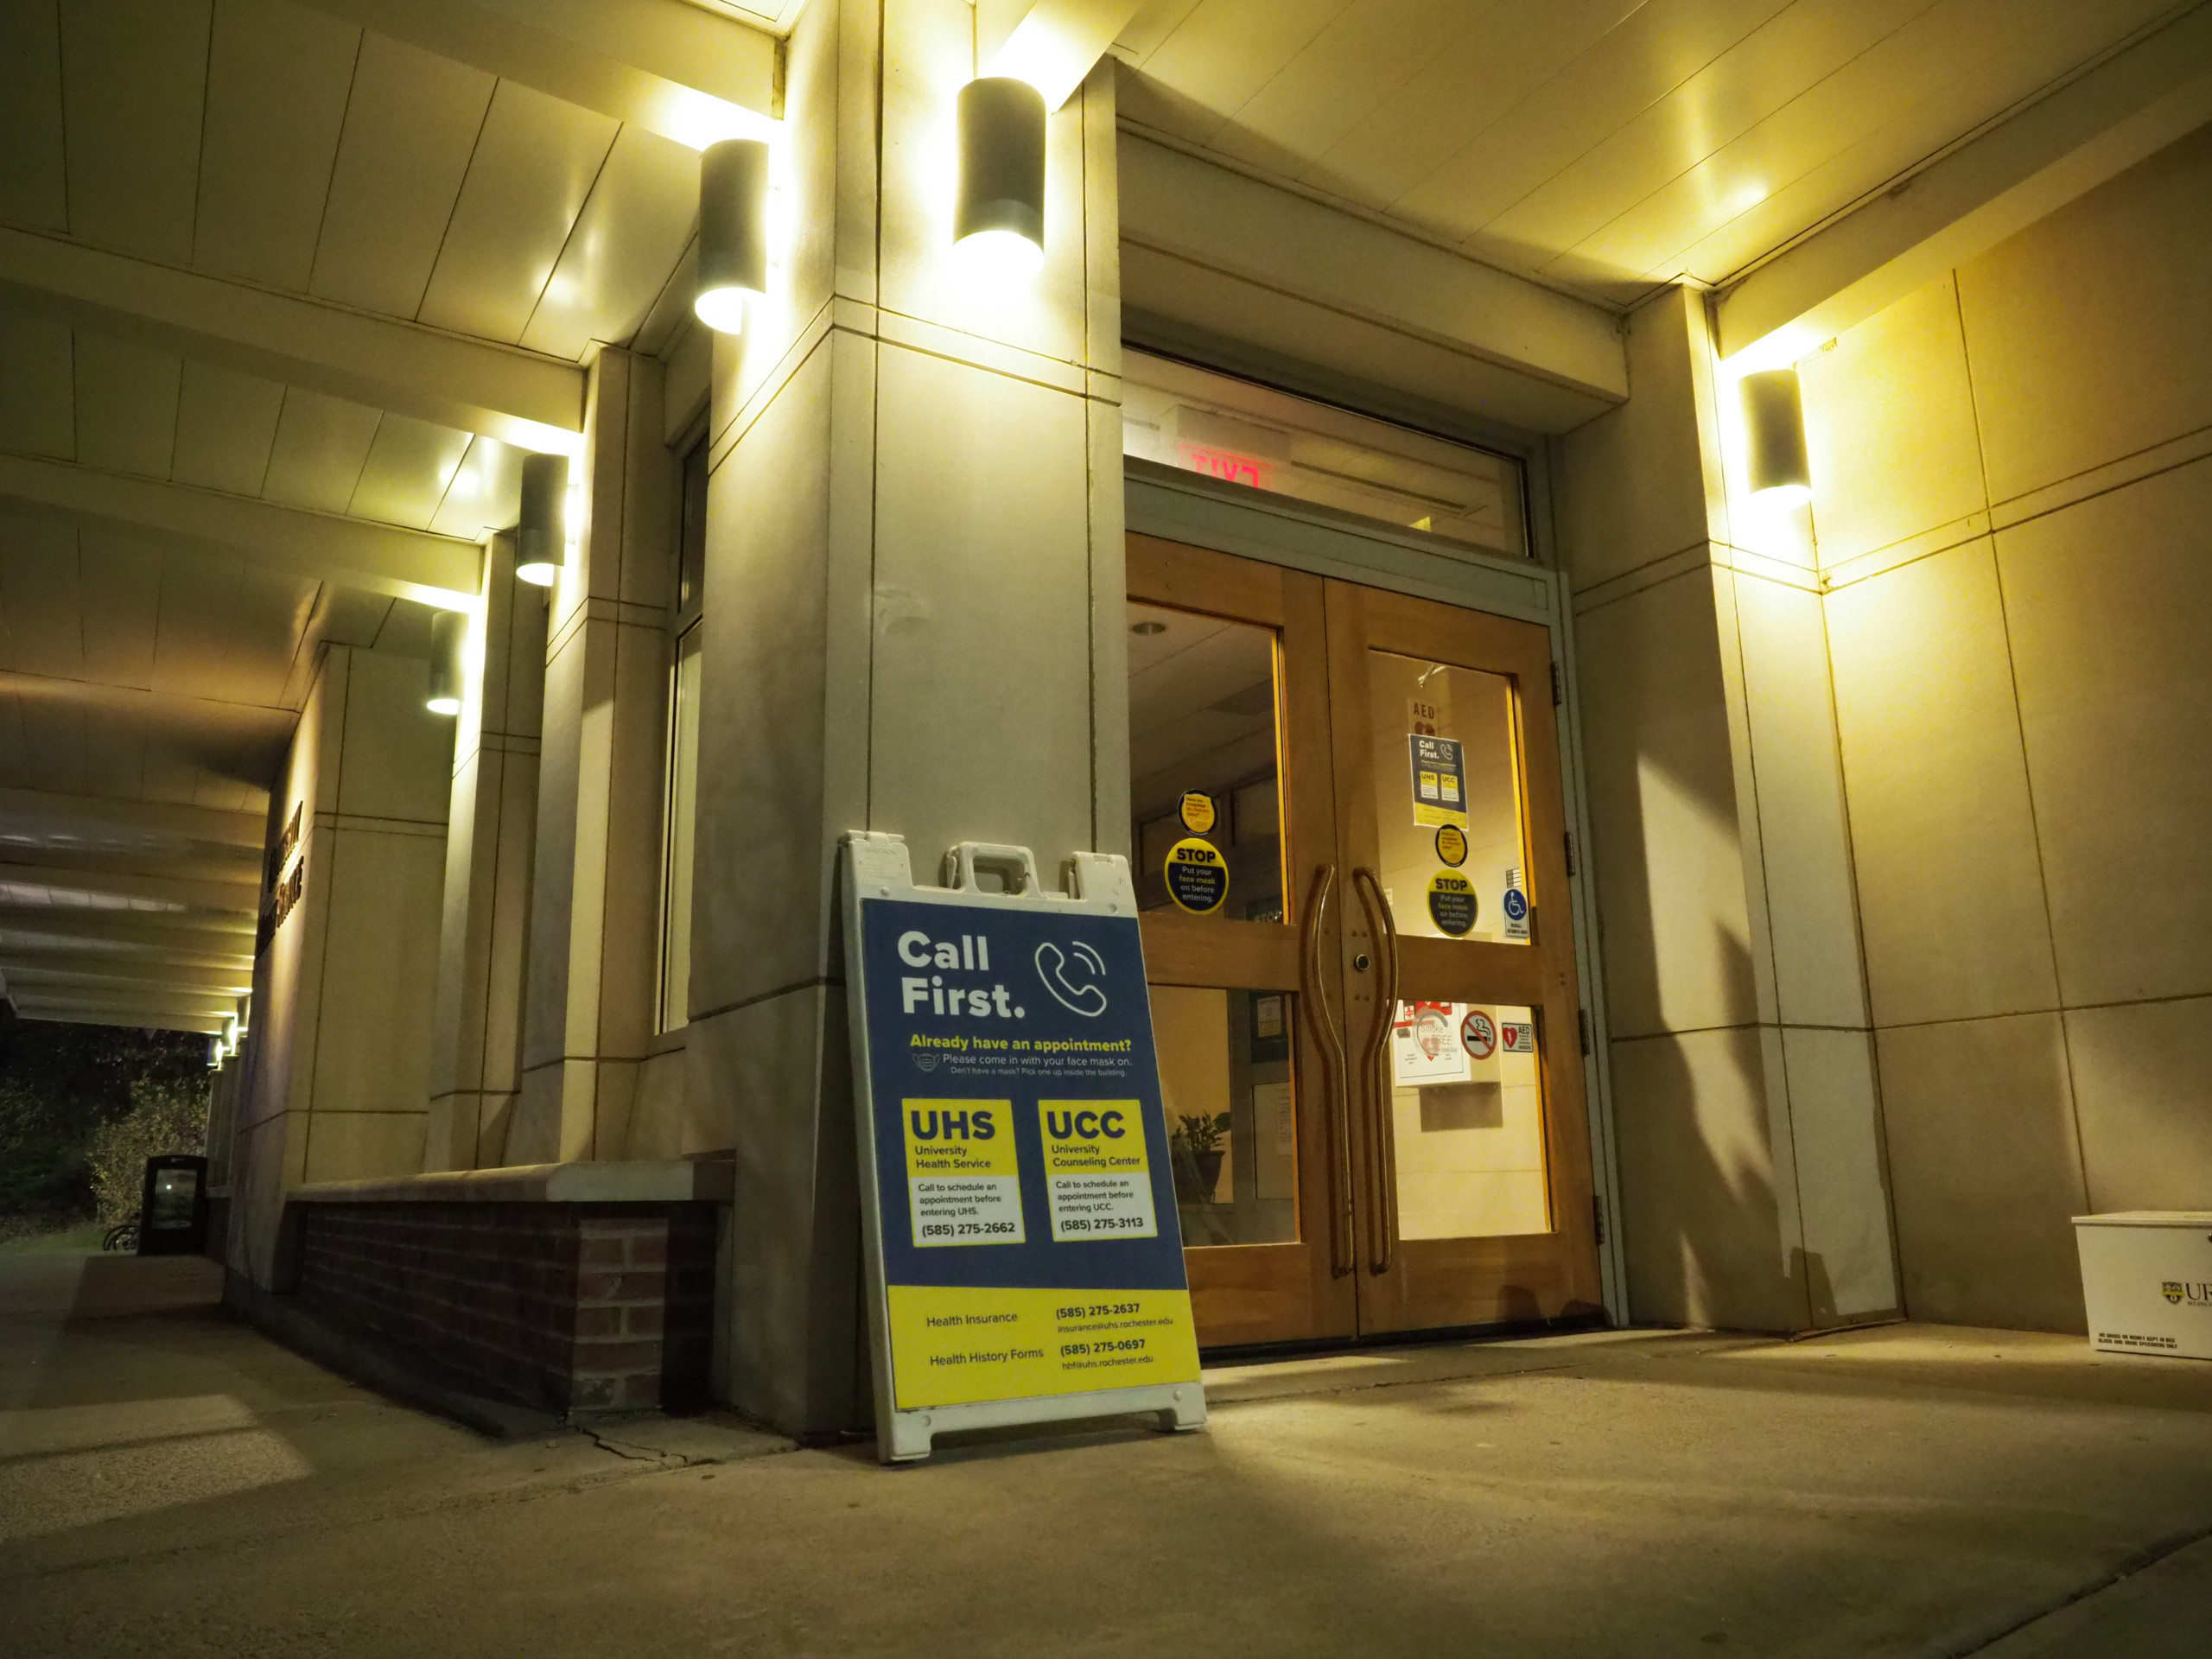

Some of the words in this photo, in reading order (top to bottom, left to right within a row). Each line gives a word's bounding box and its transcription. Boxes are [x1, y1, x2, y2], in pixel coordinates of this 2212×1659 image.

[1414, 702, 1434, 719] AED
[1419, 741, 1434, 749] Call
[1420, 749, 1440, 759] First.
[1177, 848, 1216, 862] STOP
[1196, 868, 1212, 876] your
[1192, 885, 1215, 893] before
[1436, 878, 1468, 891] STOP
[1182, 893, 1213, 903] entering.
[897, 931, 989, 970] Call
[901, 976, 1025, 1018] First.
[1421, 1025, 1444, 1033] Smoke
[1518, 1026, 1530, 1034] AED
[910, 1034, 969, 1051] Already
[973, 1036, 1008, 1049] have
[1012, 1039, 1030, 1049] an
[1034, 1038, 1131, 1053] appointment?
[1432, 1034, 1452, 1045] FREE
[943, 1053, 976, 1064] Please
[1009, 1055, 1018, 1065] in
[1043, 1058, 1065, 1067] your
[1067, 1056, 1087, 1065] face
[911, 1110, 995, 1140] UHS
[1046, 1110, 1126, 1140] UCC
[915, 1146, 968, 1156] University
[1052, 1145, 1100, 1154] University
[916, 1160, 950, 1168] Health
[953, 1159, 991, 1167] Service
[1052, 1157, 1107, 1168] Counseling
[1109, 1156, 1141, 1165] Center
[919, 1195, 973, 1205] appointment
[1058, 1192, 1107, 1201] appointment
[920, 1207, 956, 1217] entering
[1058, 1204, 1091, 1212] entering
[922, 1224, 955, 1237] (585)
[957, 1222, 1015, 1234] 275-2662
[1061, 1219, 1091, 1232] (585)
[1094, 1217, 1144, 1229] 275-3113
[1056, 1307, 1086, 1320] (585)
[1089, 1303, 1141, 1315] 275-2637
[926, 1315, 963, 1327] Health
[966, 1313, 1018, 1325] Insurance
[1058, 1318, 1173, 1333] insurance@uhs.rochester.edu
[1060, 1344, 1090, 1357] (585)
[1094, 1338, 1145, 1352] 275-0697
[930, 1353, 966, 1365] Health
[969, 1351, 1008, 1363] History
[1010, 1349, 1044, 1359] Forms
